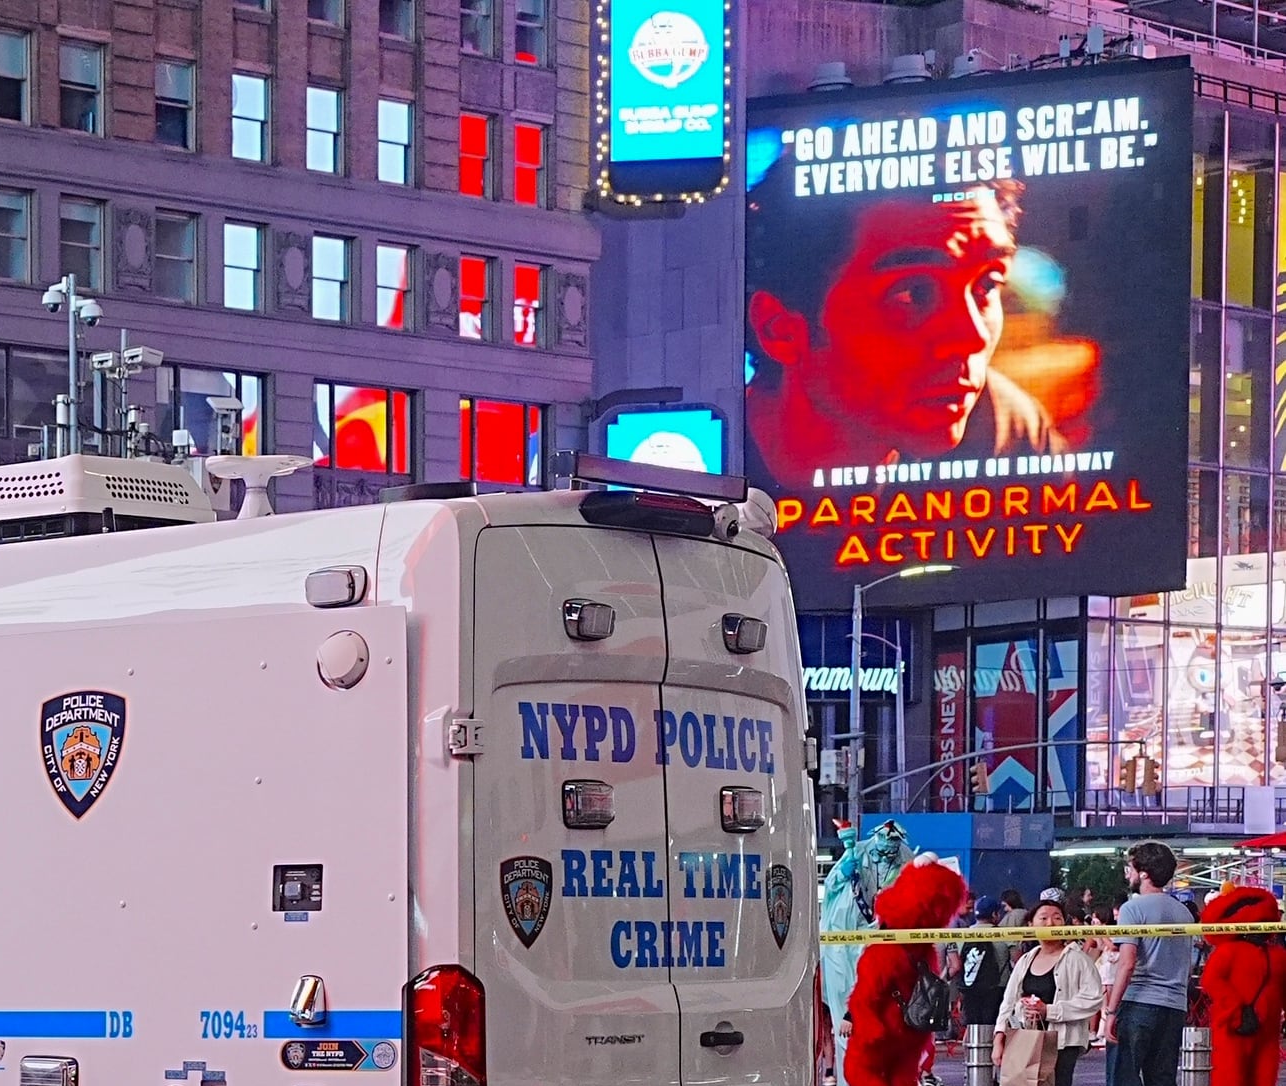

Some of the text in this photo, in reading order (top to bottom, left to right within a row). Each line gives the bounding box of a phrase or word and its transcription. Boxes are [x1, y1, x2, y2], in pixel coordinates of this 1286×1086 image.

[842, 117, 937, 157] AHEAD
[947, 110, 1006, 148] AND
[794, 154, 935, 197] EVERYONE
[945, 147, 1012, 183] ELSE
[1021, 139, 1090, 177] WILL
[813, 451, 1115, 487] A NEW STORY NOW ON BROADWAY
[777, 479, 1153, 532] PARANORMAL
[836, 522, 1085, 566] ACTIVITY
[802, 661, 905, 695] ramount
[45, 708, 120, 732] DEPARTMENT
[62, 695, 104, 710] POLICE
[518, 701, 775, 774] NYPD POLICE
[44, 745, 67, 793] CITY OF
[90, 736, 120, 797] NEW YORK
[504, 869, 550, 883] DEPARTMENT
[514, 860, 540, 870] POLICE
[561, 849, 761, 899] REAL TIME
[610, 920, 725, 968] CRIME
[108, 1010, 134, 1038] DB
[200, 1010, 258, 1039] 7094 23
[585, 1034, 644, 1046] TRANSIT
[317, 1042, 338, 1051] JOIN
